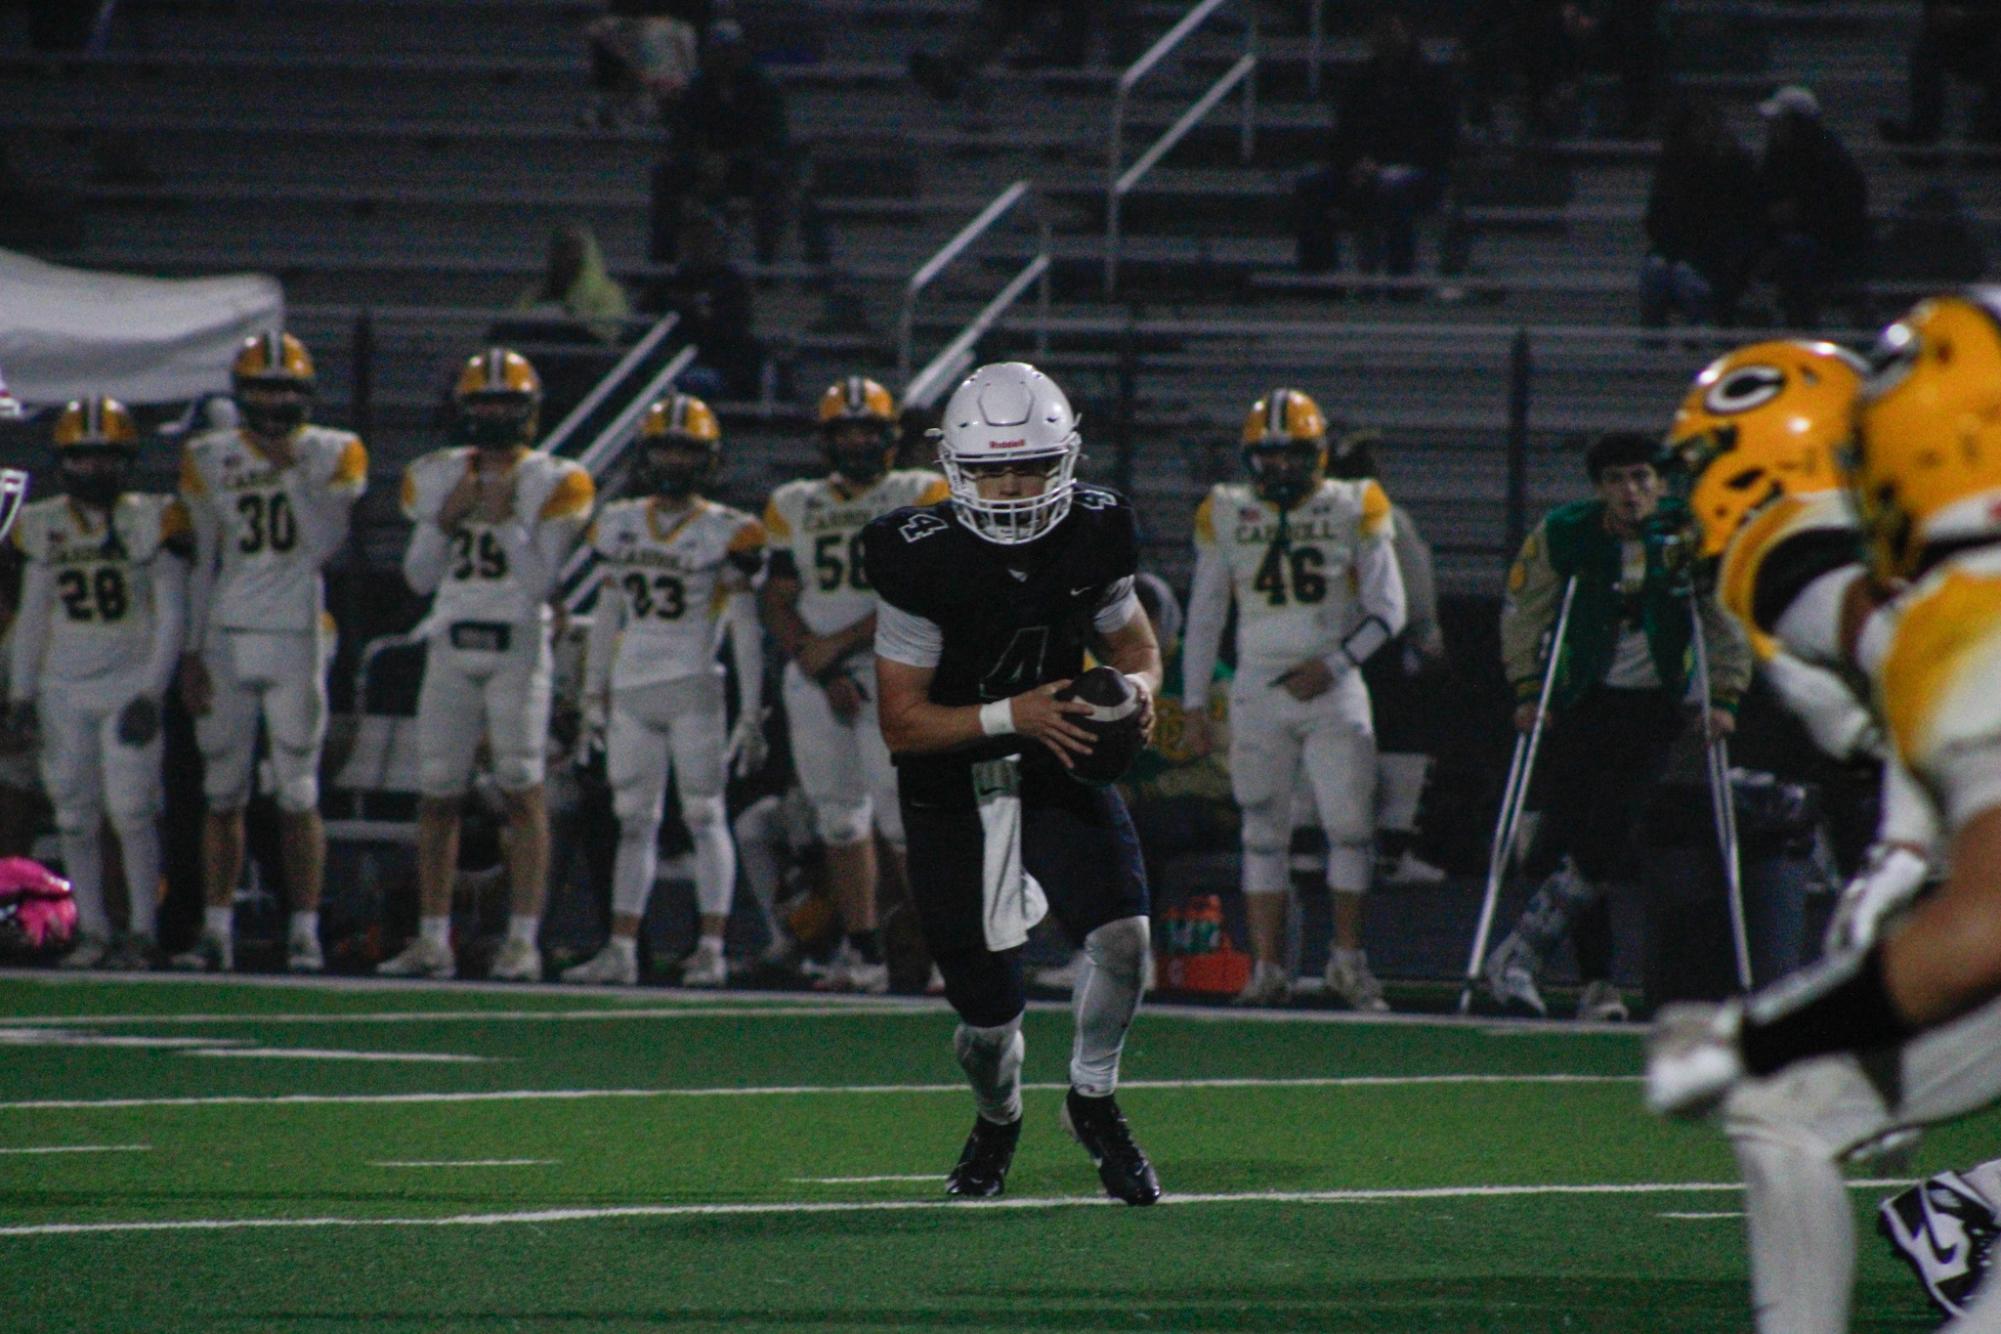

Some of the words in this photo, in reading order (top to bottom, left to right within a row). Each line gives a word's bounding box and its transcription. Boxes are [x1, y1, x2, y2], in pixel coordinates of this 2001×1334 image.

[1703, 364, 1786, 415] C
[238, 492, 297, 555] 30
[899, 513, 950, 544] 4
[58, 568, 127, 621] 28
[1254, 546, 1327, 606] 46
[978, 625, 1050, 700] 4
